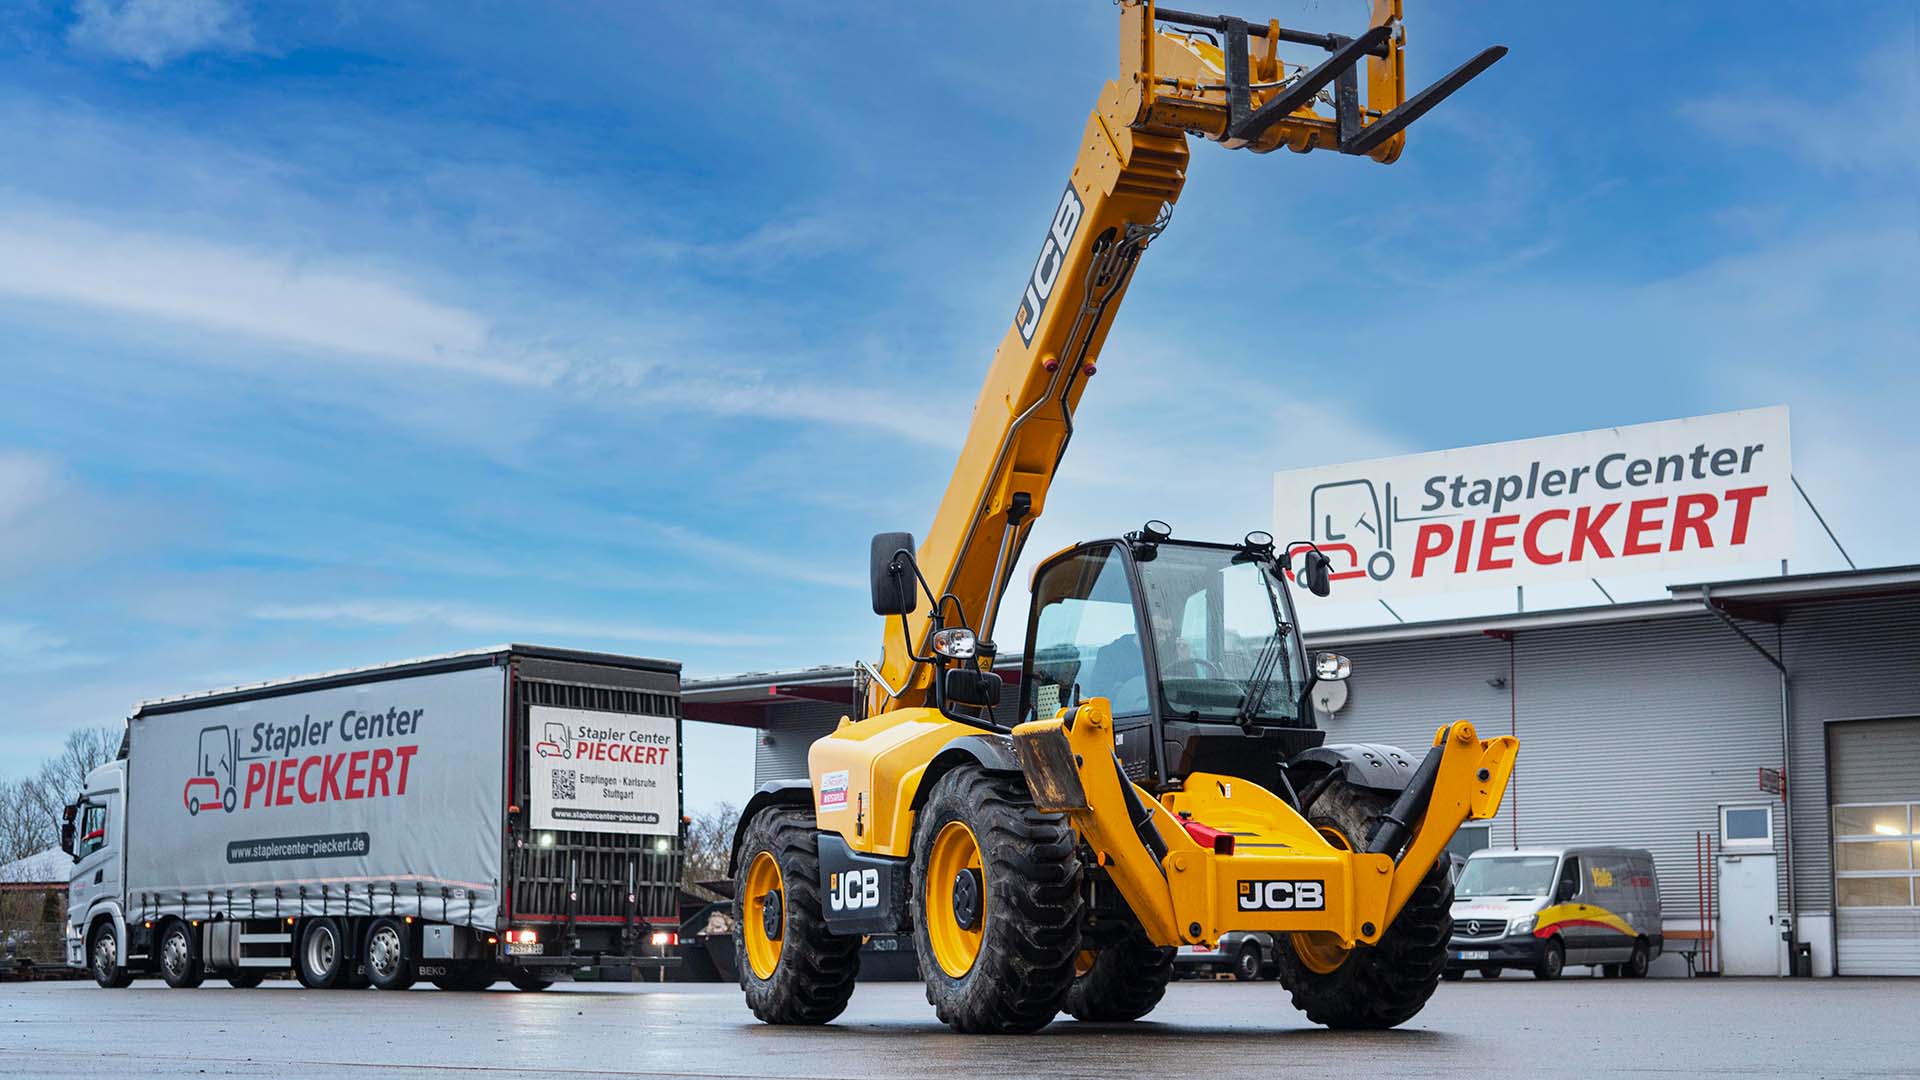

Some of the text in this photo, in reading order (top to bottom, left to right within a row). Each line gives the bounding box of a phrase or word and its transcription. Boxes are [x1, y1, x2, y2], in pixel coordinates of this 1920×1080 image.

[1022, 189, 1081, 340] JCB
[1411, 485, 1768, 578] PIECKERT
[251, 706, 423, 757] Stapler Center
[578, 726, 671, 745] Stapler Center
[575, 742, 669, 765] PIECKERT
[243, 745, 418, 809] PIECKERT
[580, 774, 656, 788] Empfingen Karlsruhe
[603, 789, 634, 800] Stuttgart
[554, 810, 657, 823] www.staplercenter-pieckert.de
[231, 836, 365, 859] www.staplercenter-pieckert.de
[830, 868, 880, 911] JCB
[1239, 882, 1324, 909] JCB
[419, 966, 446, 976] BEKO
